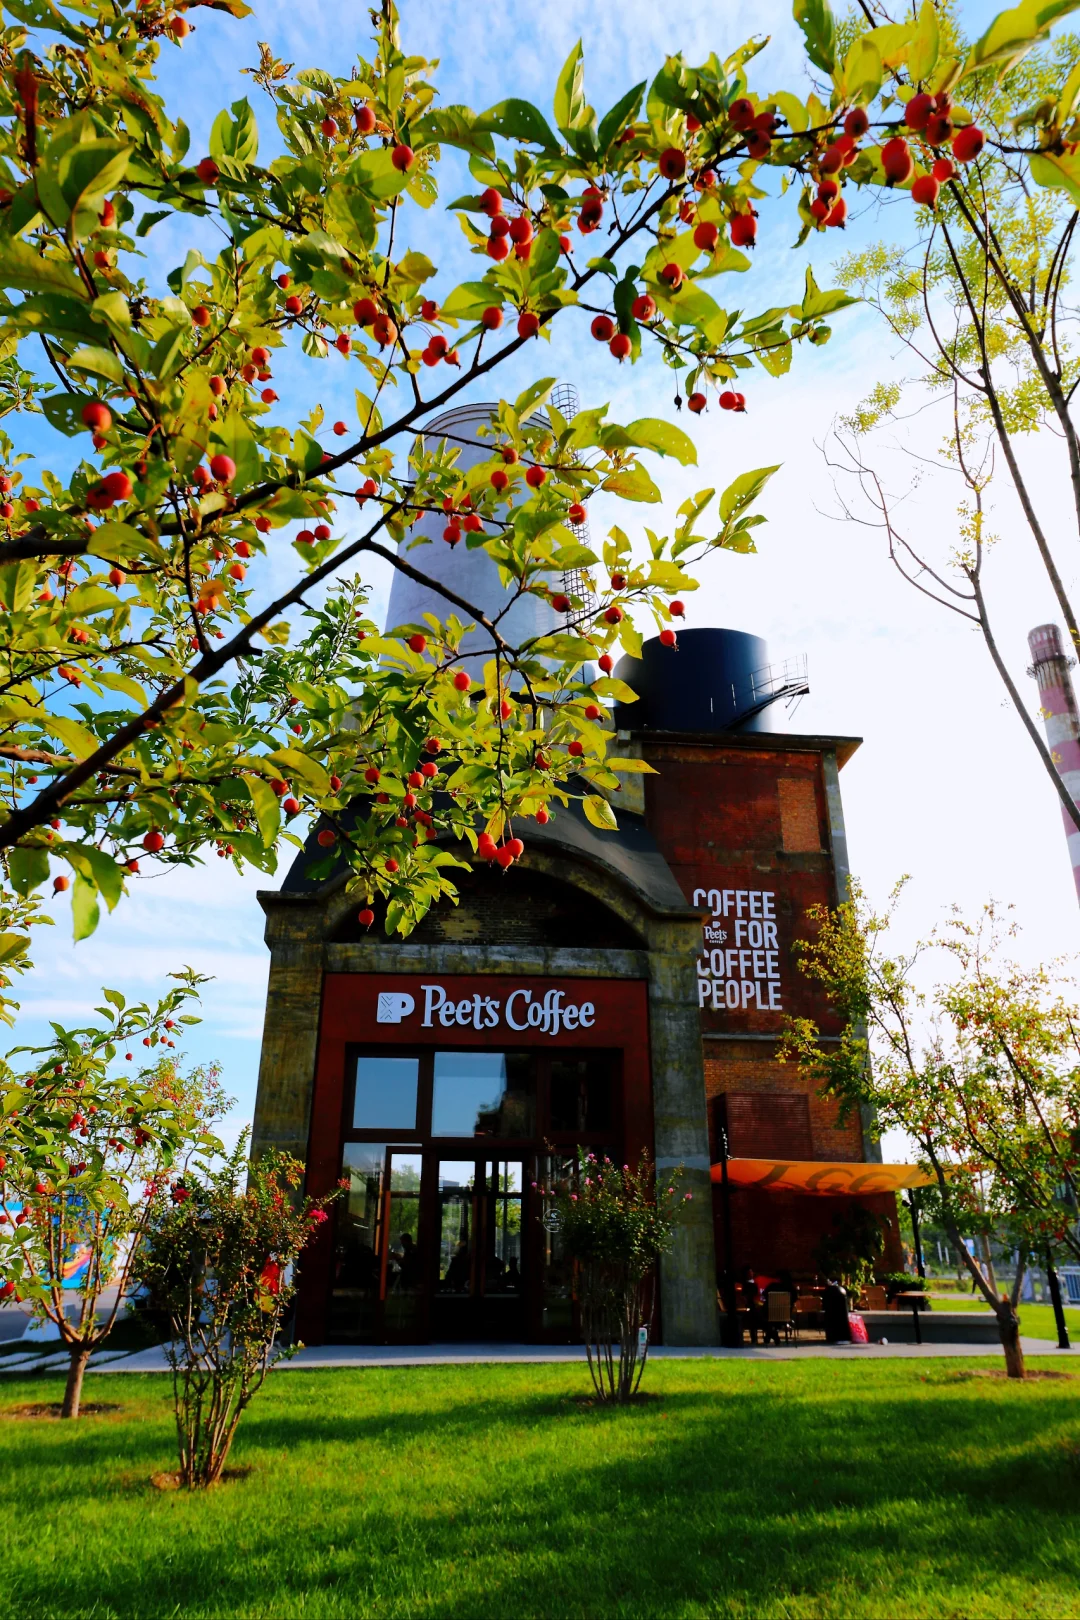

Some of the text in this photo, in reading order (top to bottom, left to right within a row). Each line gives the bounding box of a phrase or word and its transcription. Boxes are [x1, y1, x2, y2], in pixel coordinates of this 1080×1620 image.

[693, 888, 776, 919] COFFEE
[703, 926, 728, 941] Peet's
[735, 920, 779, 949] FOR
[420, 984, 596, 1036] Peet's Coffee
[697, 979, 783, 1010] PEOPLE
